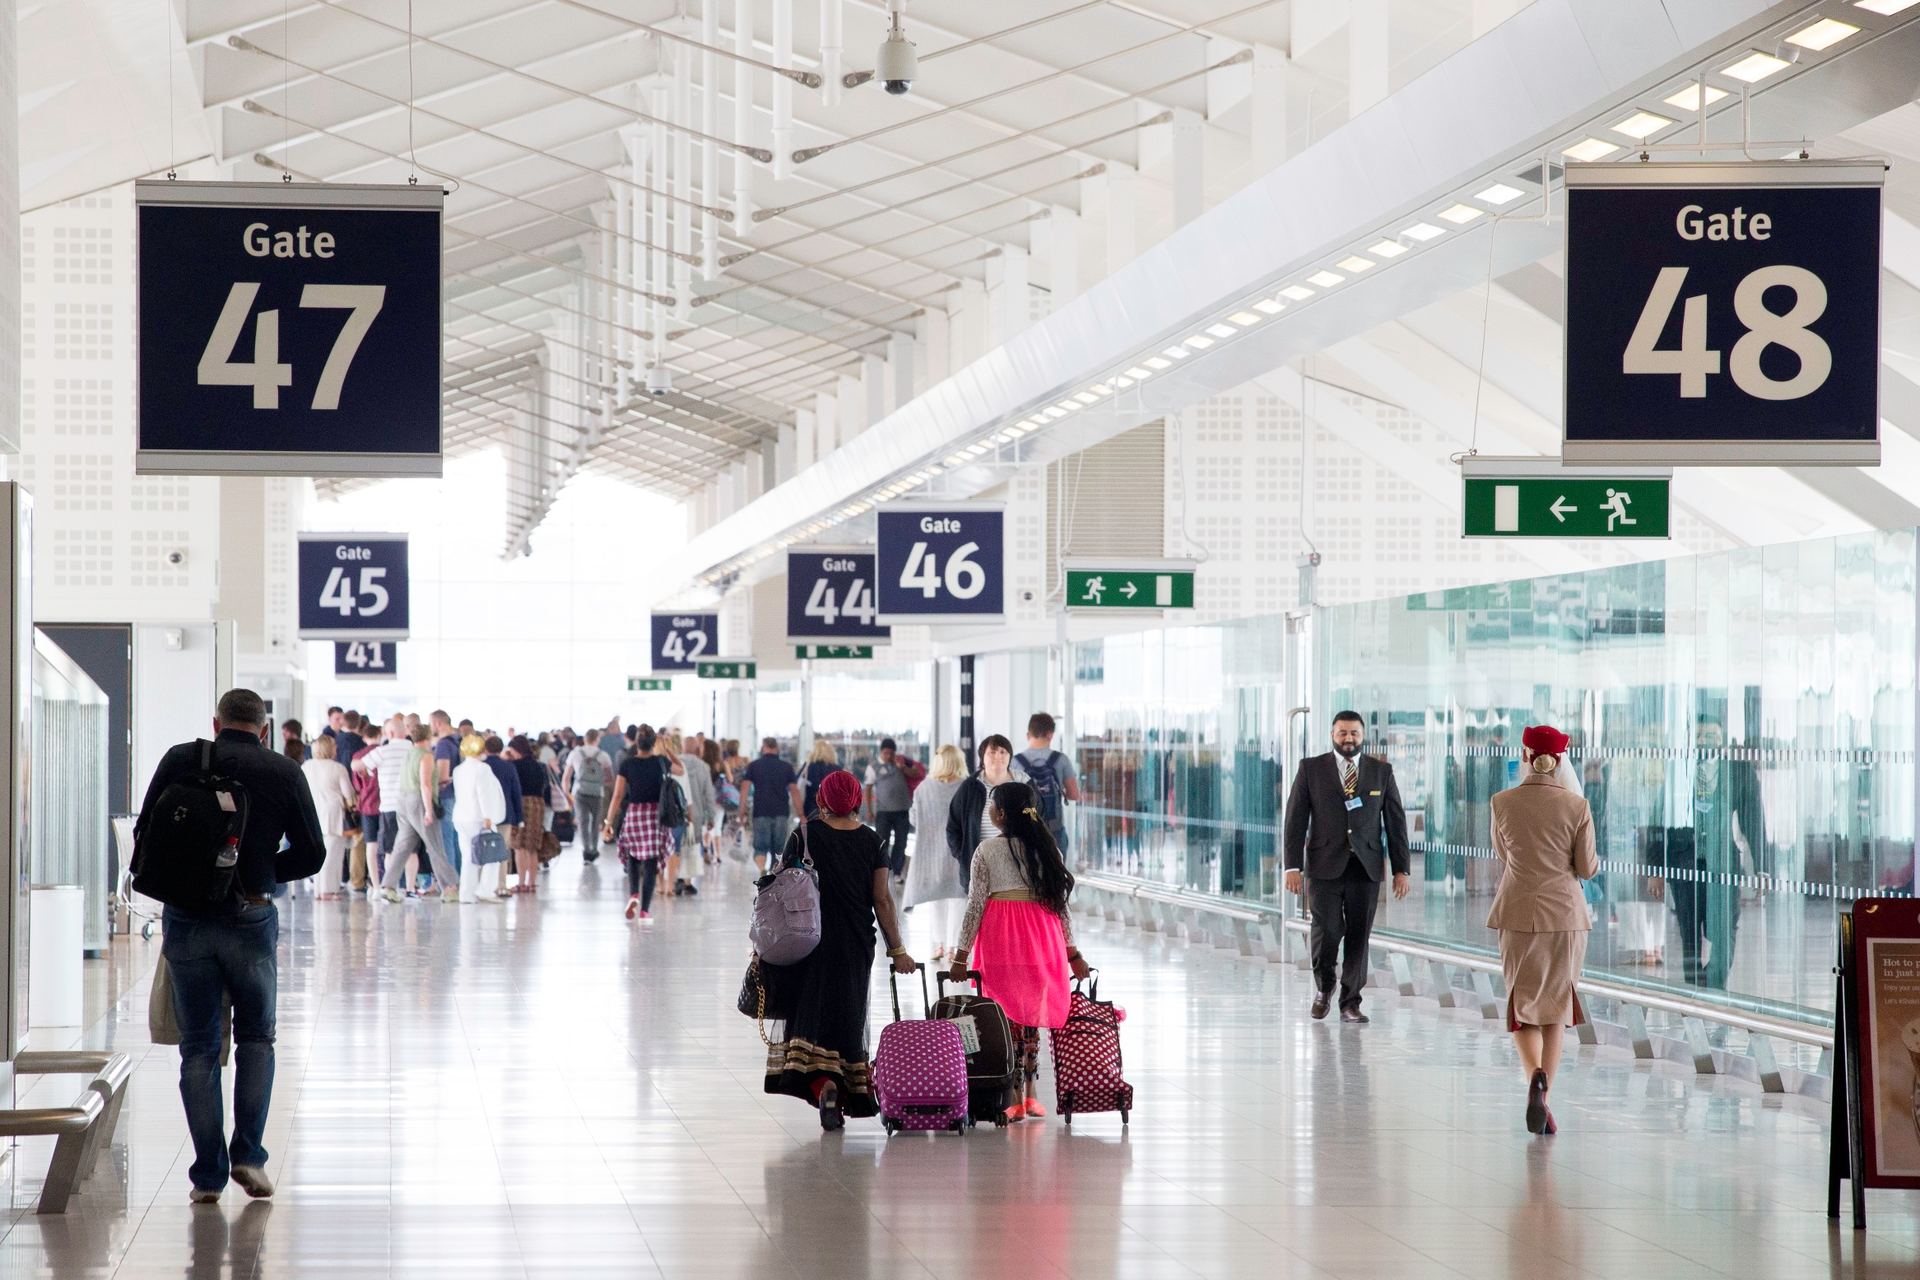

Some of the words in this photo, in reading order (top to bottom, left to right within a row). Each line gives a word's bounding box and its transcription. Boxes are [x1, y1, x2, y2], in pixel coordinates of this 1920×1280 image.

[1676, 205, 1772, 241] Gate
[243, 222, 335, 258] Gate
[197, 282, 387, 410] 47
[1622, 264, 1833, 401] 48
[920, 517, 961, 534] Gate
[336, 545, 371, 560] Gate
[822, 558, 856, 572] Gate
[899, 541, 986, 600] 46
[319, 567, 389, 617] 45
[804, 578, 875, 625] 44
[672, 616, 696, 628] Gate
[345, 641, 385, 668] 41
[661, 630, 708, 663] 42
[1883, 958, 1900, 966] Hot
[1903, 959, 1913, 967] to
[1895, 969, 1914, 978] just
